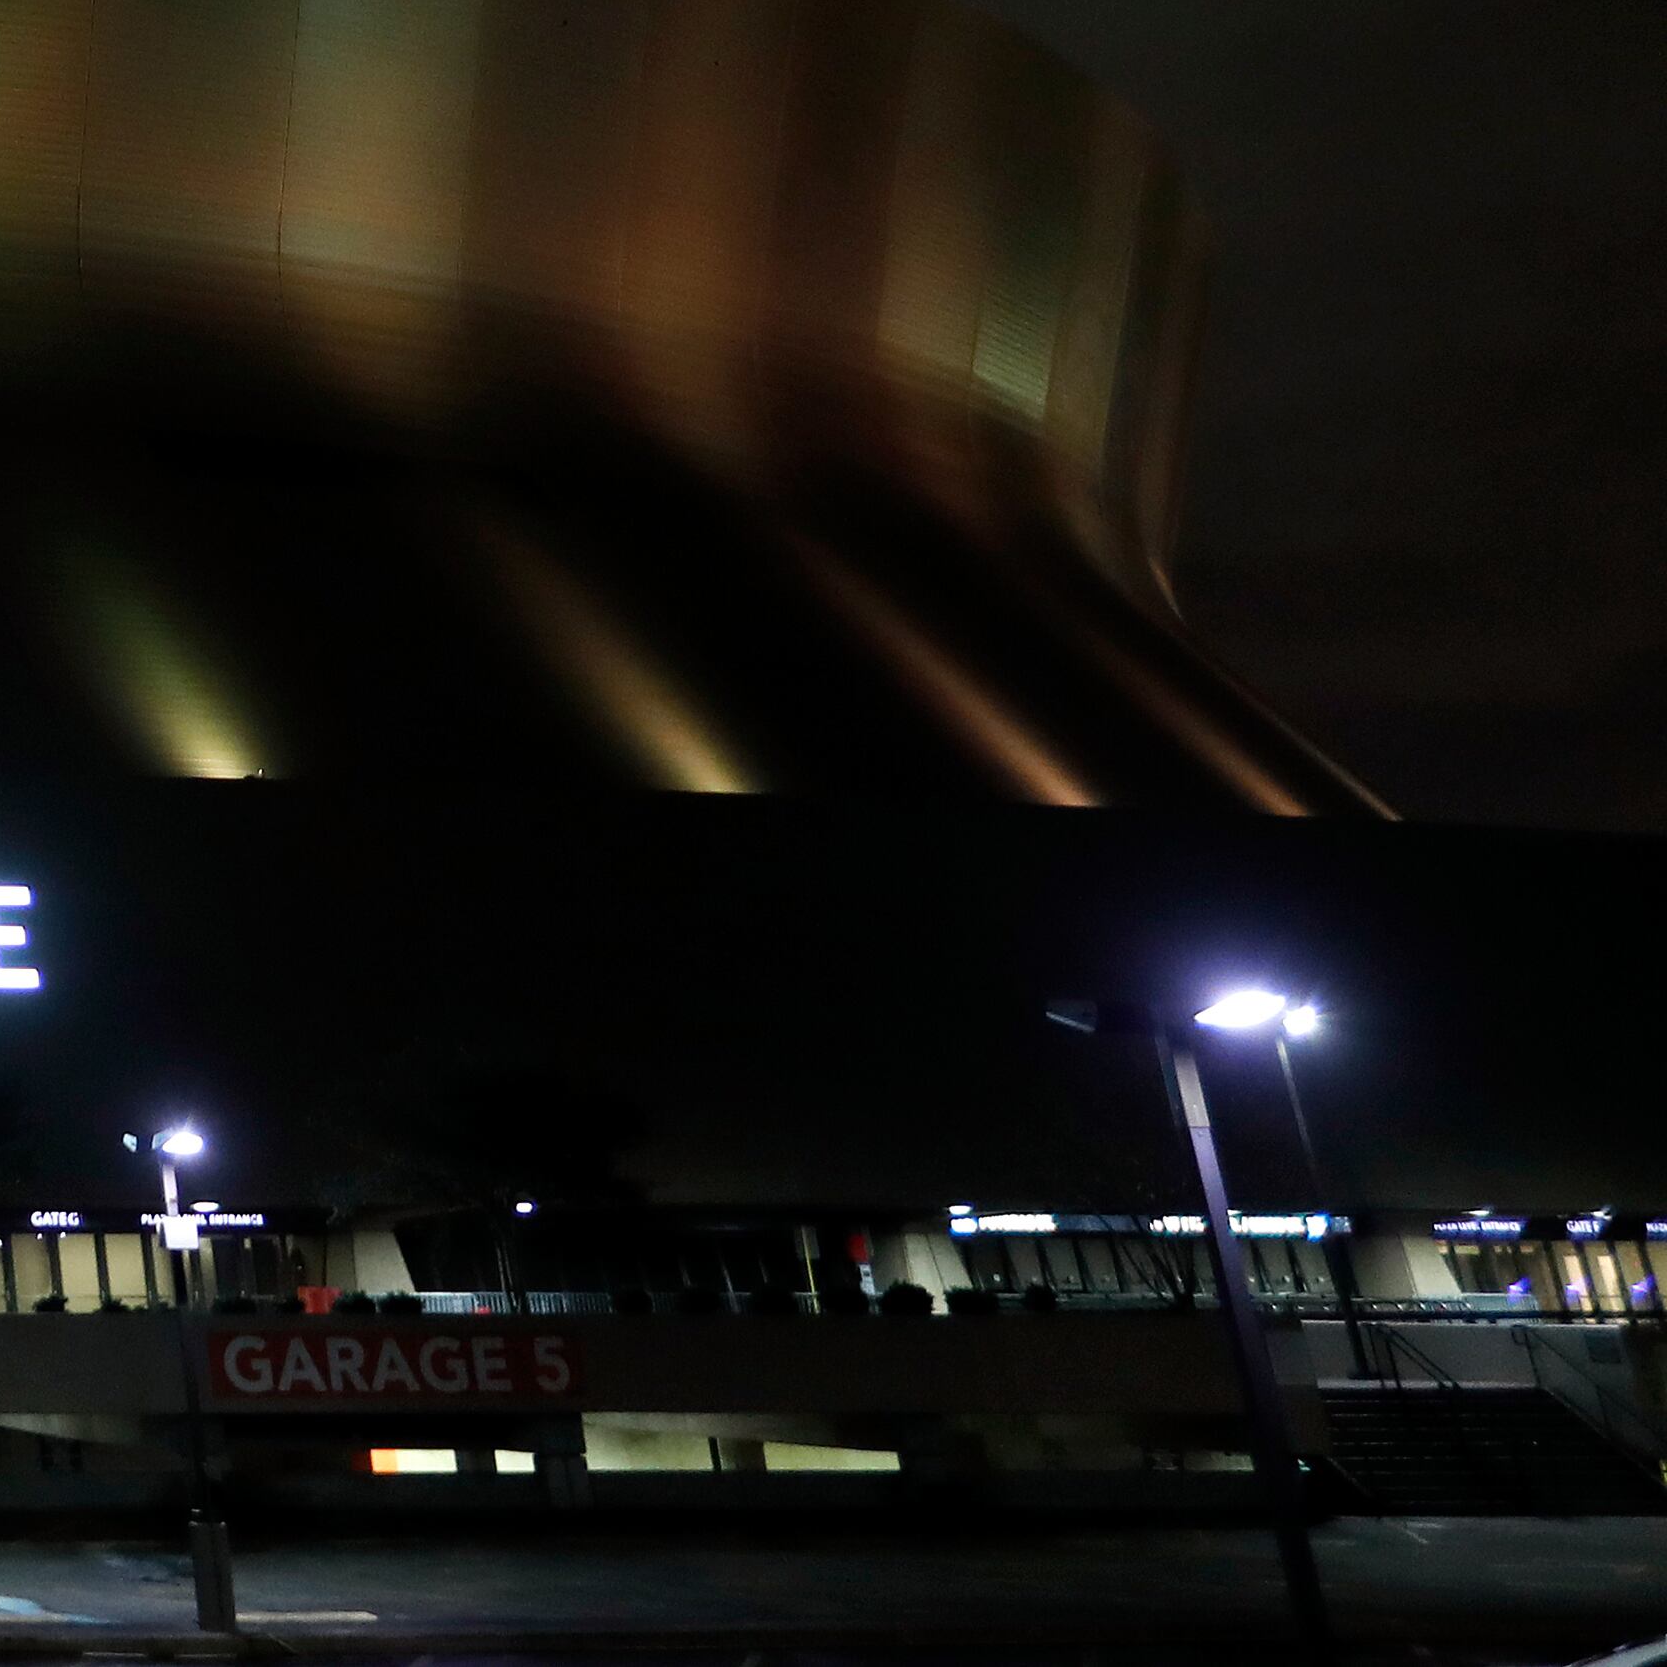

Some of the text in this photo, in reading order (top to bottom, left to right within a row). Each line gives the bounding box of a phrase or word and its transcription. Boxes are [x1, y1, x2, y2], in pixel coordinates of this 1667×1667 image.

[208, 1214, 264, 1225] ENTRANCE
[1566, 1220, 1592, 1232] GATE
[223, 1334, 571, 1393] GARAGE 5
